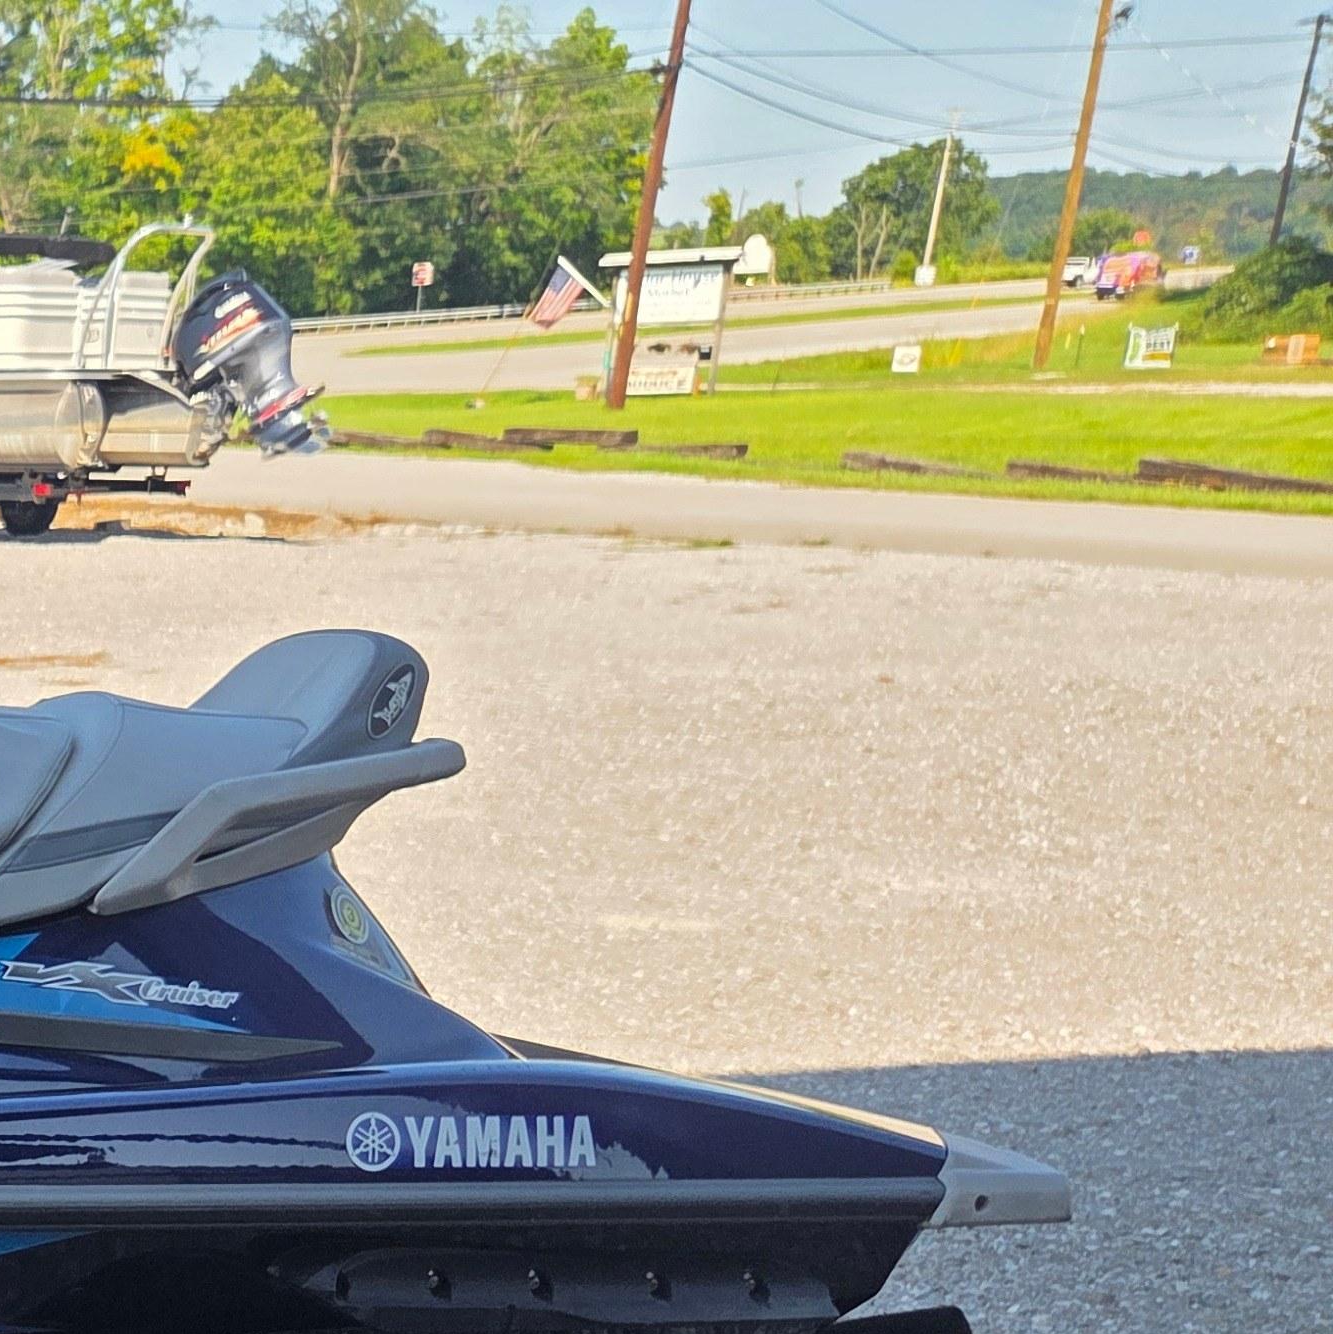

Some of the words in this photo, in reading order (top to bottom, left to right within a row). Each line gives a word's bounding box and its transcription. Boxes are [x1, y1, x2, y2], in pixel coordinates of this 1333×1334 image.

[0, 960, 165, 1007] VX
[138, 980, 240, 1009] Cruiser
[404, 1115, 597, 1168] YAMAHA
